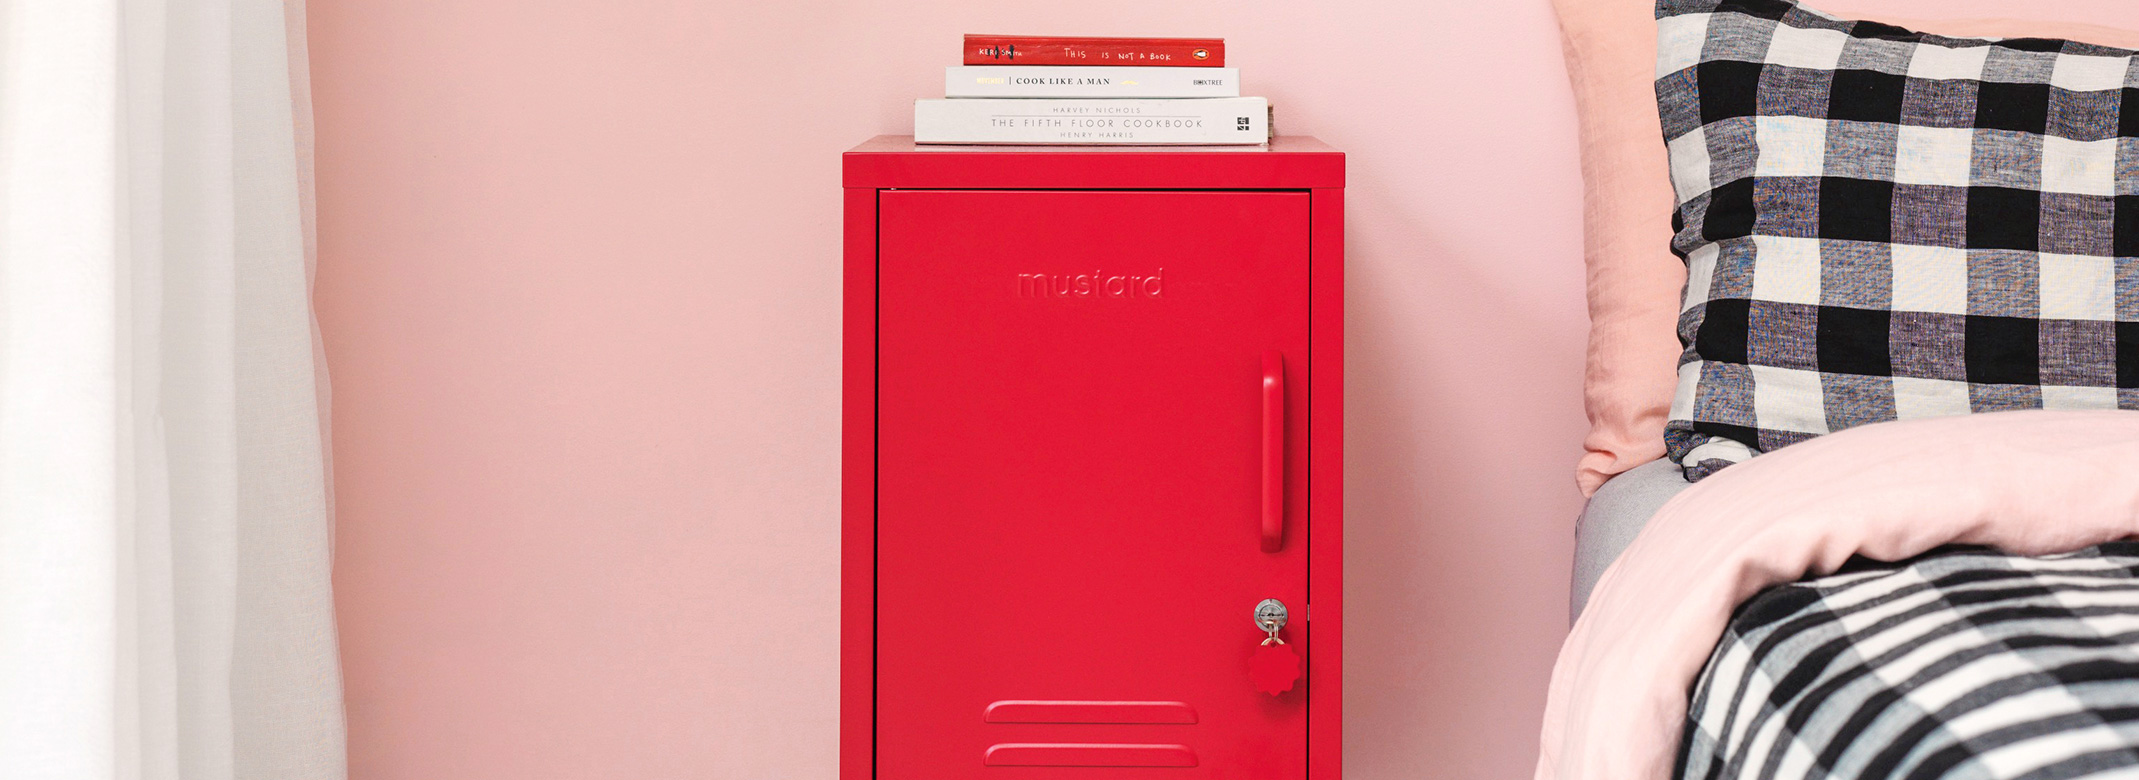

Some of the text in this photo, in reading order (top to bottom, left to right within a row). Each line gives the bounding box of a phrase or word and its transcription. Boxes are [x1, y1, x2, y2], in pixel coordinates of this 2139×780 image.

[1064, 47, 1086, 59] THIS
[1118, 52, 1134, 60] NOT
[1150, 52, 1171, 60] BOOK
[1016, 77, 1045, 85] COOK
[992, 119, 1202, 128] THE FIFTH FLOOR COOKBOOK
[1017, 267, 1164, 299] mustard
